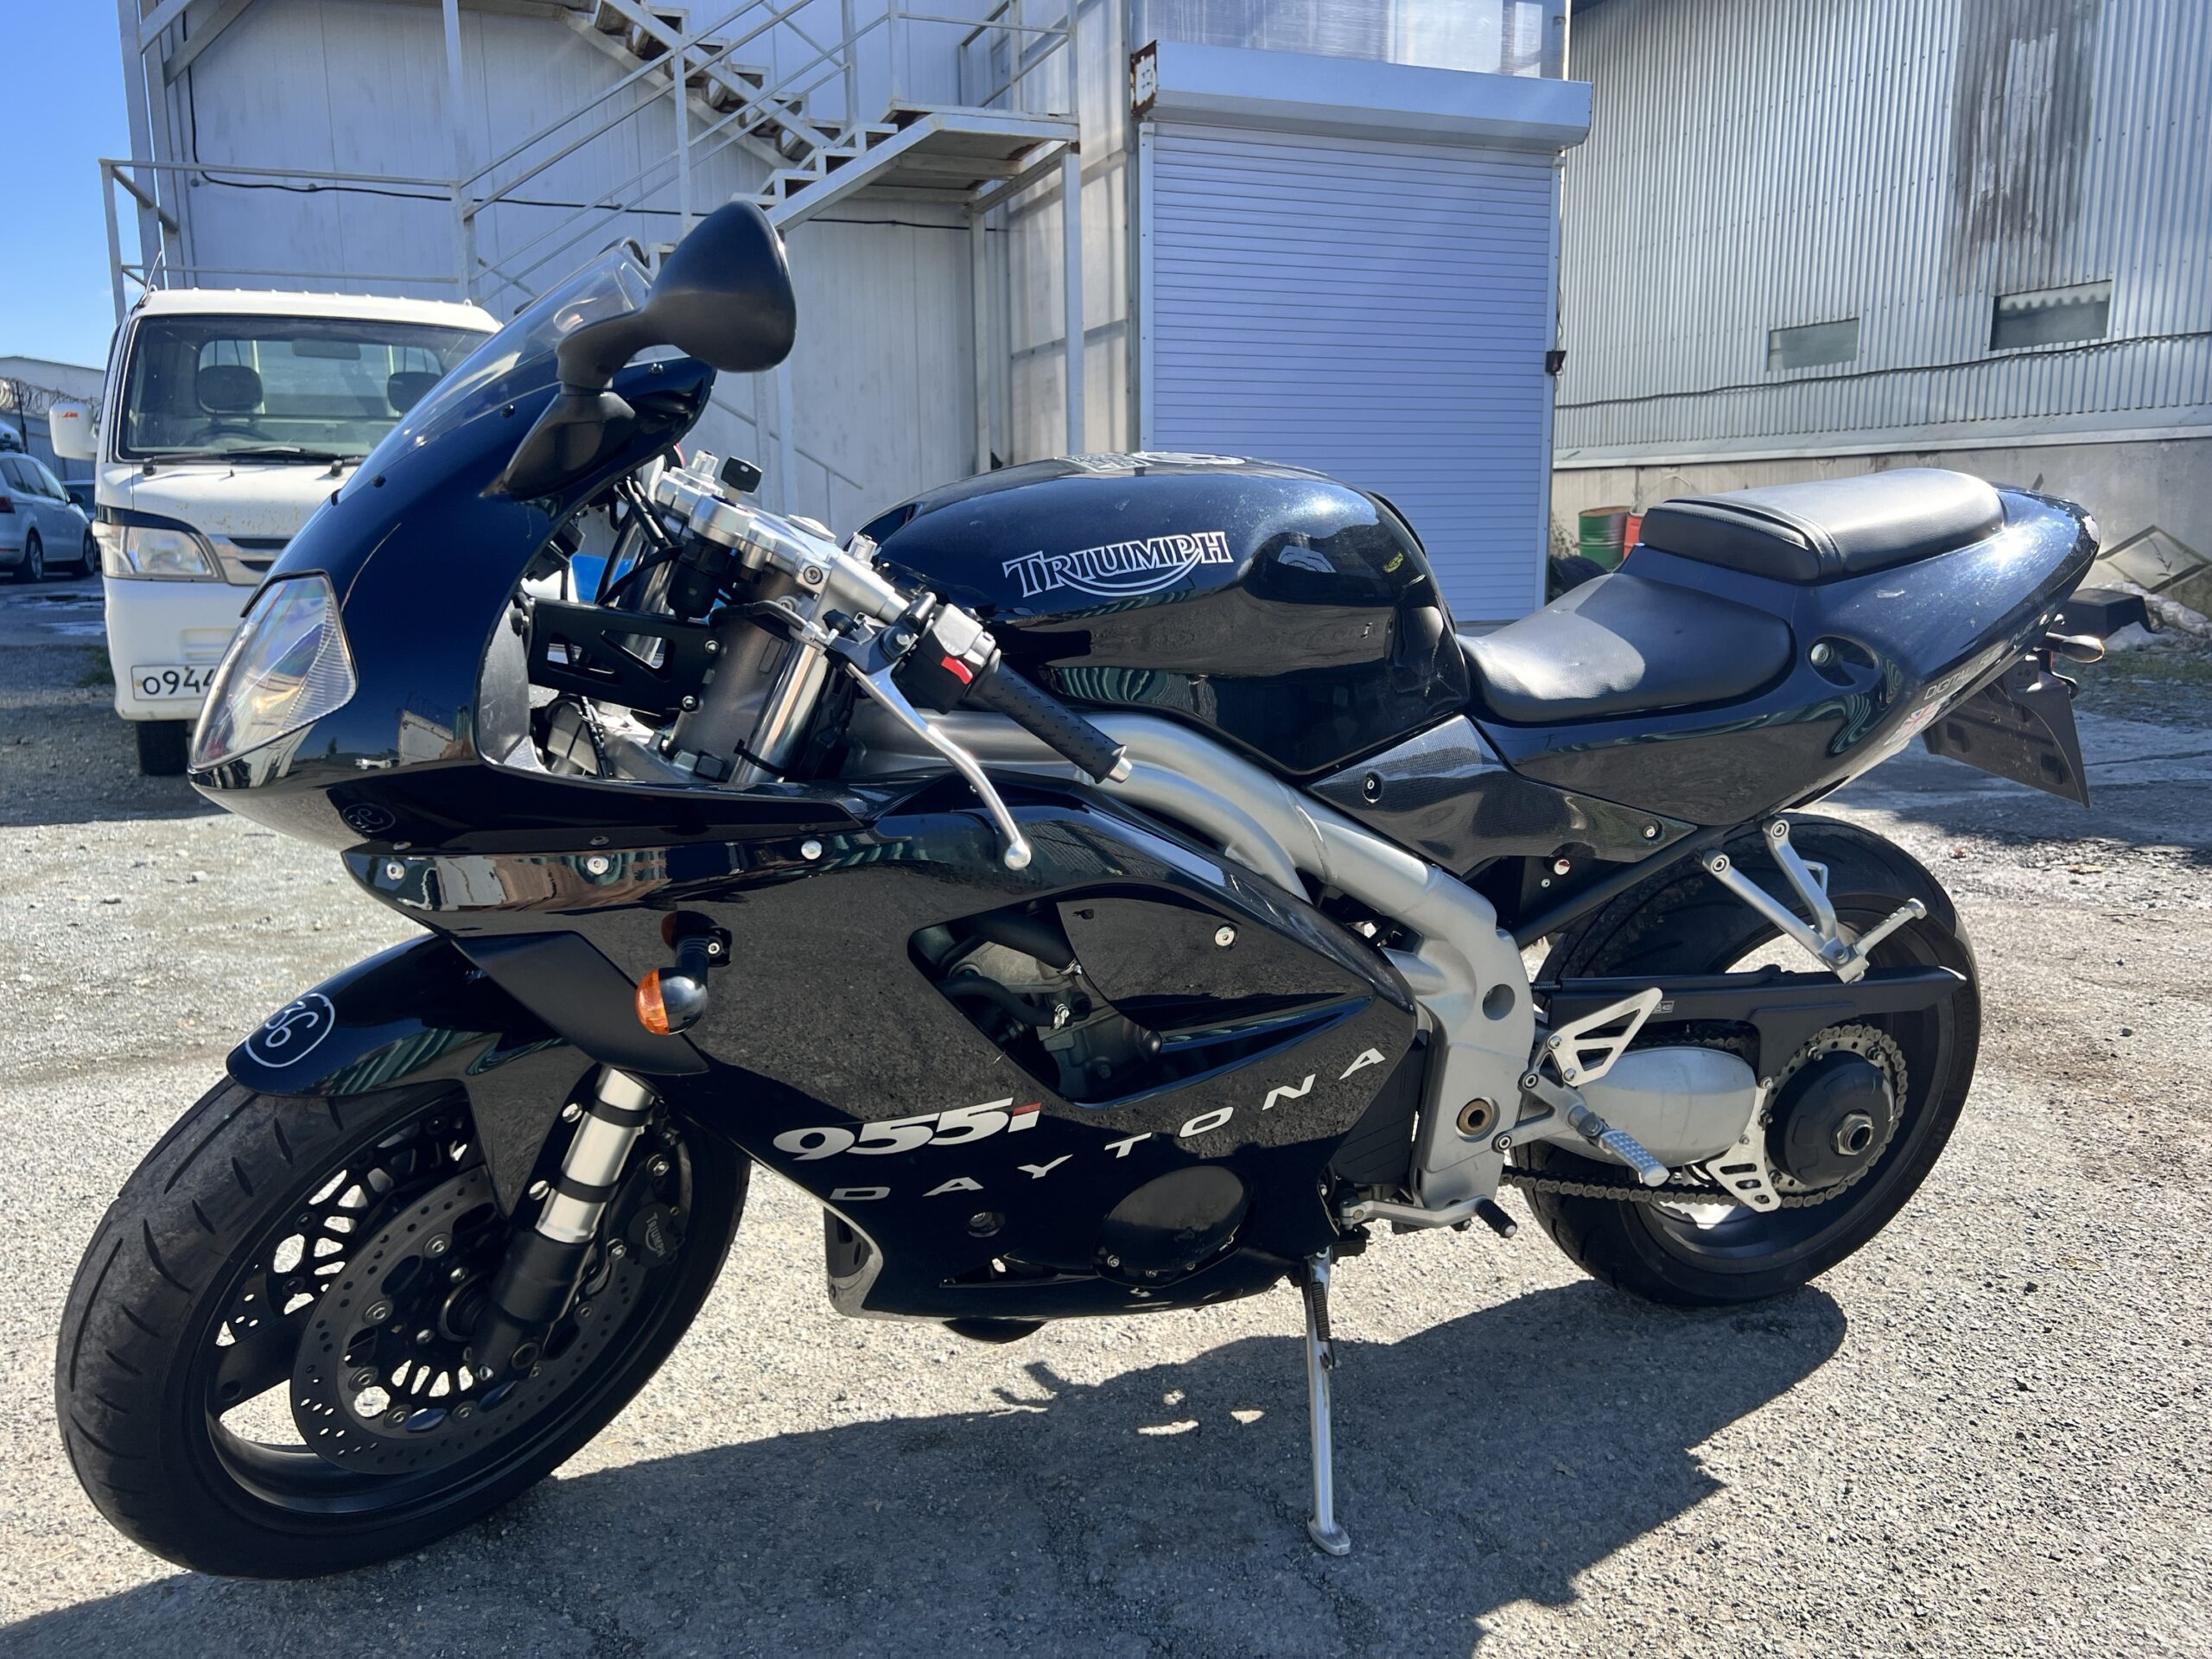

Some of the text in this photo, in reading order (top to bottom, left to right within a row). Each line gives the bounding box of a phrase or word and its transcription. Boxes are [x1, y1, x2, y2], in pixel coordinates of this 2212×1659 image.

[1002, 531, 1234, 598] TRIUMPH
[1923, 667, 1971, 701] DIGITAL
[772, 1096, 1042, 1161] 955i
[830, 1048, 1385, 1201] DAYTONA
[645, 1212, 665, 1258] TRIUMPH
